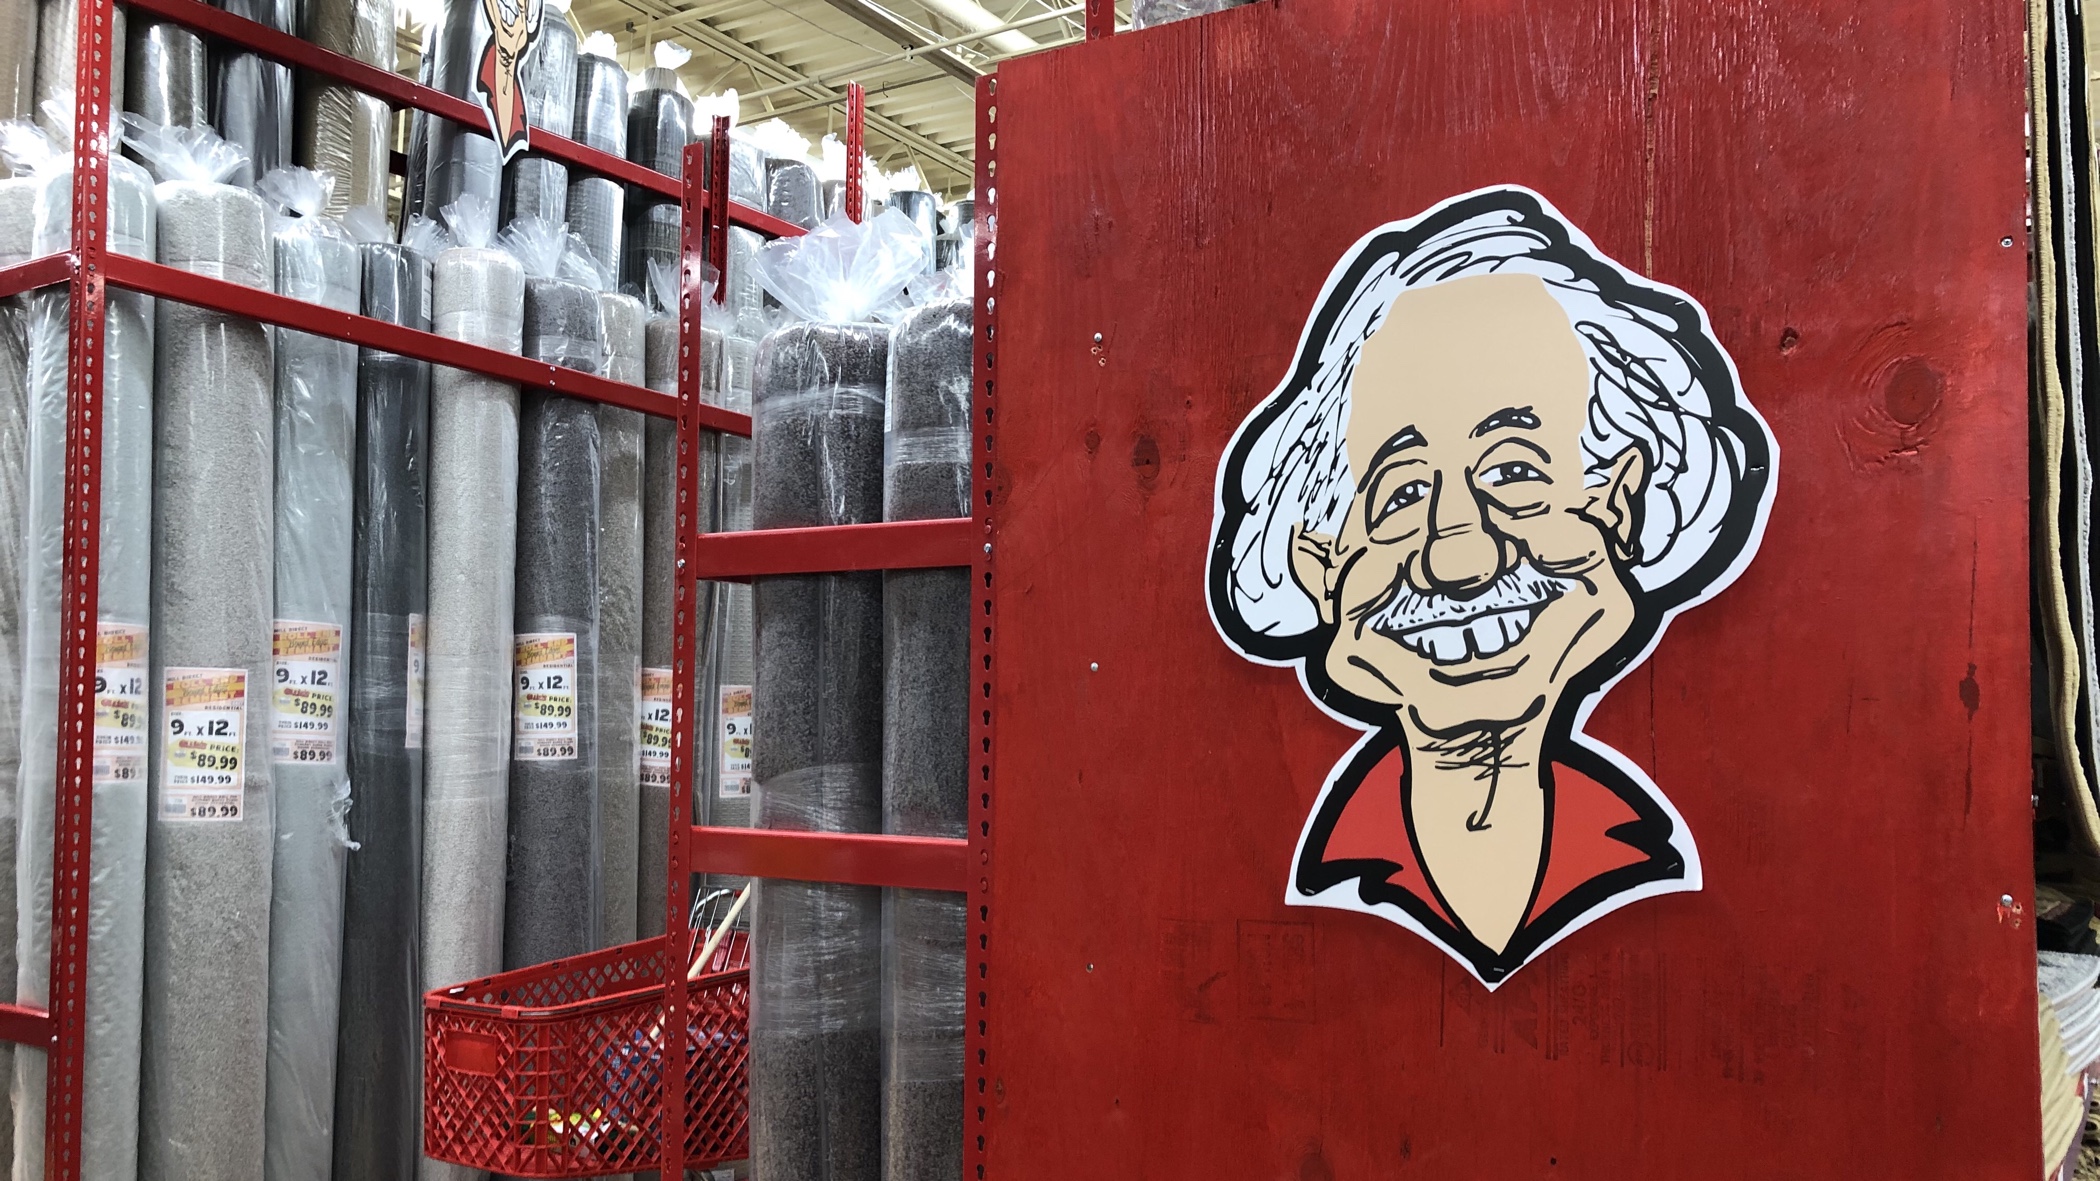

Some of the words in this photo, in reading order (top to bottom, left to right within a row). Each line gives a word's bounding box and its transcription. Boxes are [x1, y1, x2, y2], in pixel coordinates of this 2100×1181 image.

[276, 668, 290, 683] 9
[311, 670, 328, 685] 12
[520, 676, 530, 690] 9
[547, 676, 563, 689] 12
[130, 678, 142, 695] 12
[294, 698, 334, 718] $89.99
[534, 702, 571, 717] $89.99
[655, 708, 670, 722] 12
[171, 719, 184, 736] 9
[208, 720, 229, 736] 12
[294, 721, 328, 730] $149.99
[726, 723, 736, 734] 9
[293, 750, 332, 762] $89.99
[537, 746, 574, 756] $89.99
[190, 752, 238, 770] $89.99
[190, 775, 232, 784] $149.99
[190, 806, 238, 818] $89.99
